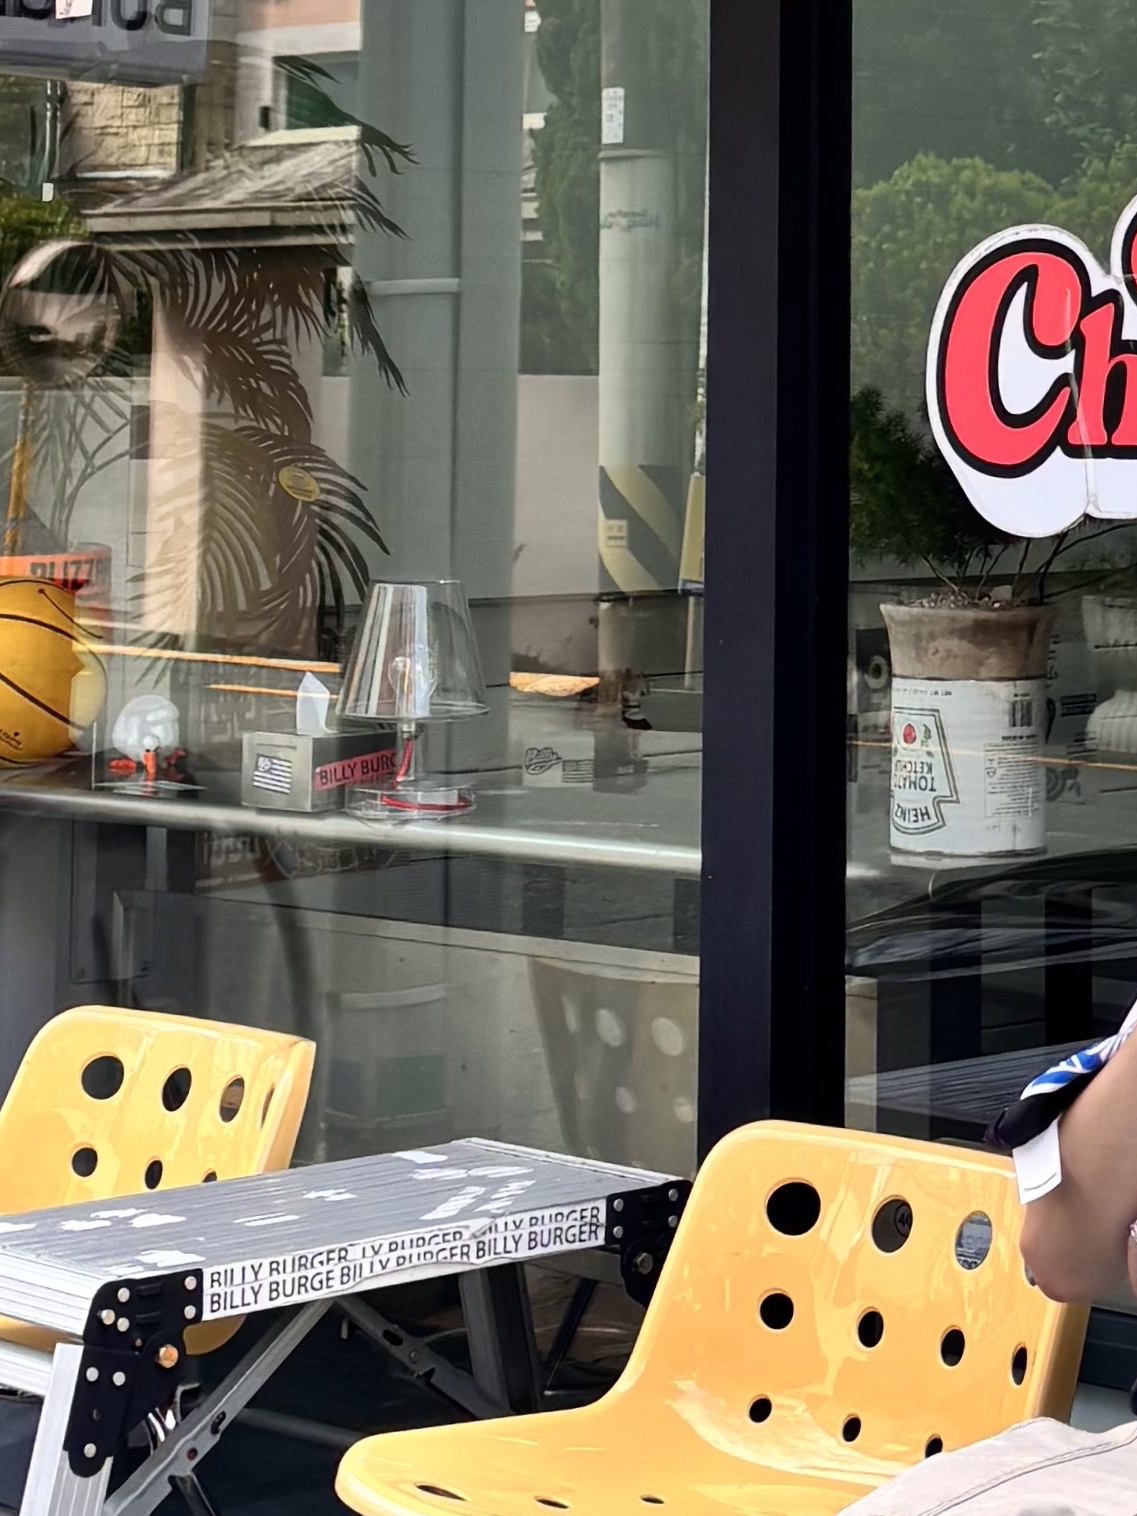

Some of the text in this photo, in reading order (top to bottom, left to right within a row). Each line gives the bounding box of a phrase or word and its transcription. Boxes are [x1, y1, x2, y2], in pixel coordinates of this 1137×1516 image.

[319, 762, 357, 786] BILLY
[894, 803, 932, 823] HEINZ
[210, 1284, 263, 1313] BILLY
[269, 1269, 334, 1302] BURGE
[476, 1233, 523, 1259] BILLY
[528, 1222, 599, 1250] BURGER
